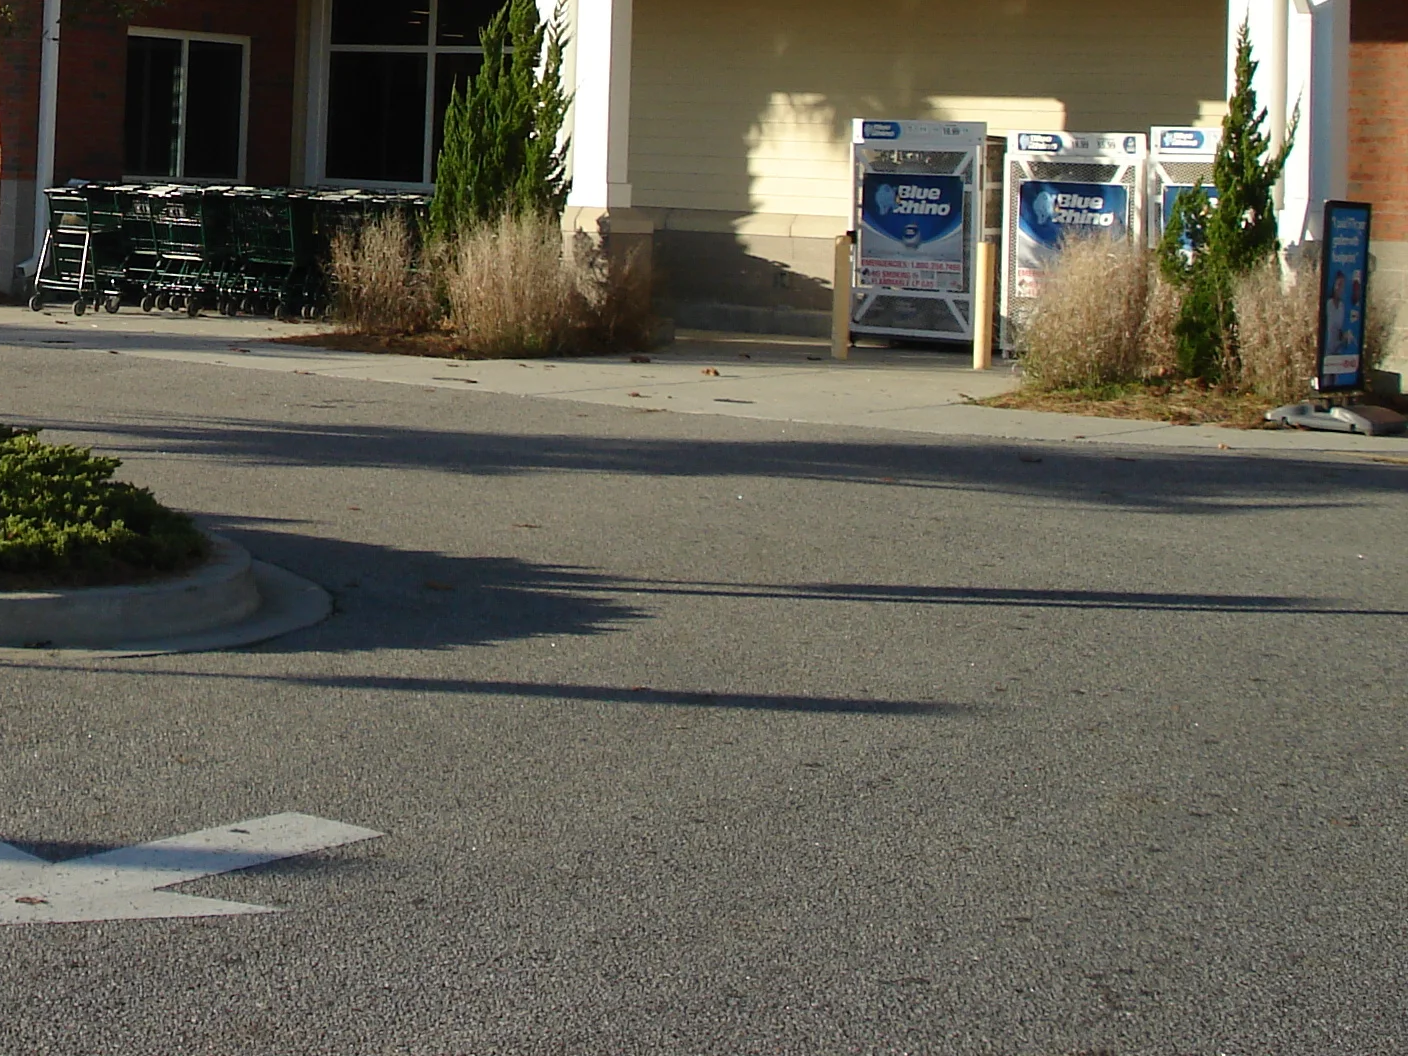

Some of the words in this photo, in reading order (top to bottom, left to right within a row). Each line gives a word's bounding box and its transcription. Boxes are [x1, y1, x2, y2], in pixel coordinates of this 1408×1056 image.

[897, 184, 941, 200] Blue
[892, 199, 951, 216] Rhino
[1057, 193, 1104, 210] Blue
[1052, 208, 1114, 227] Rhino
